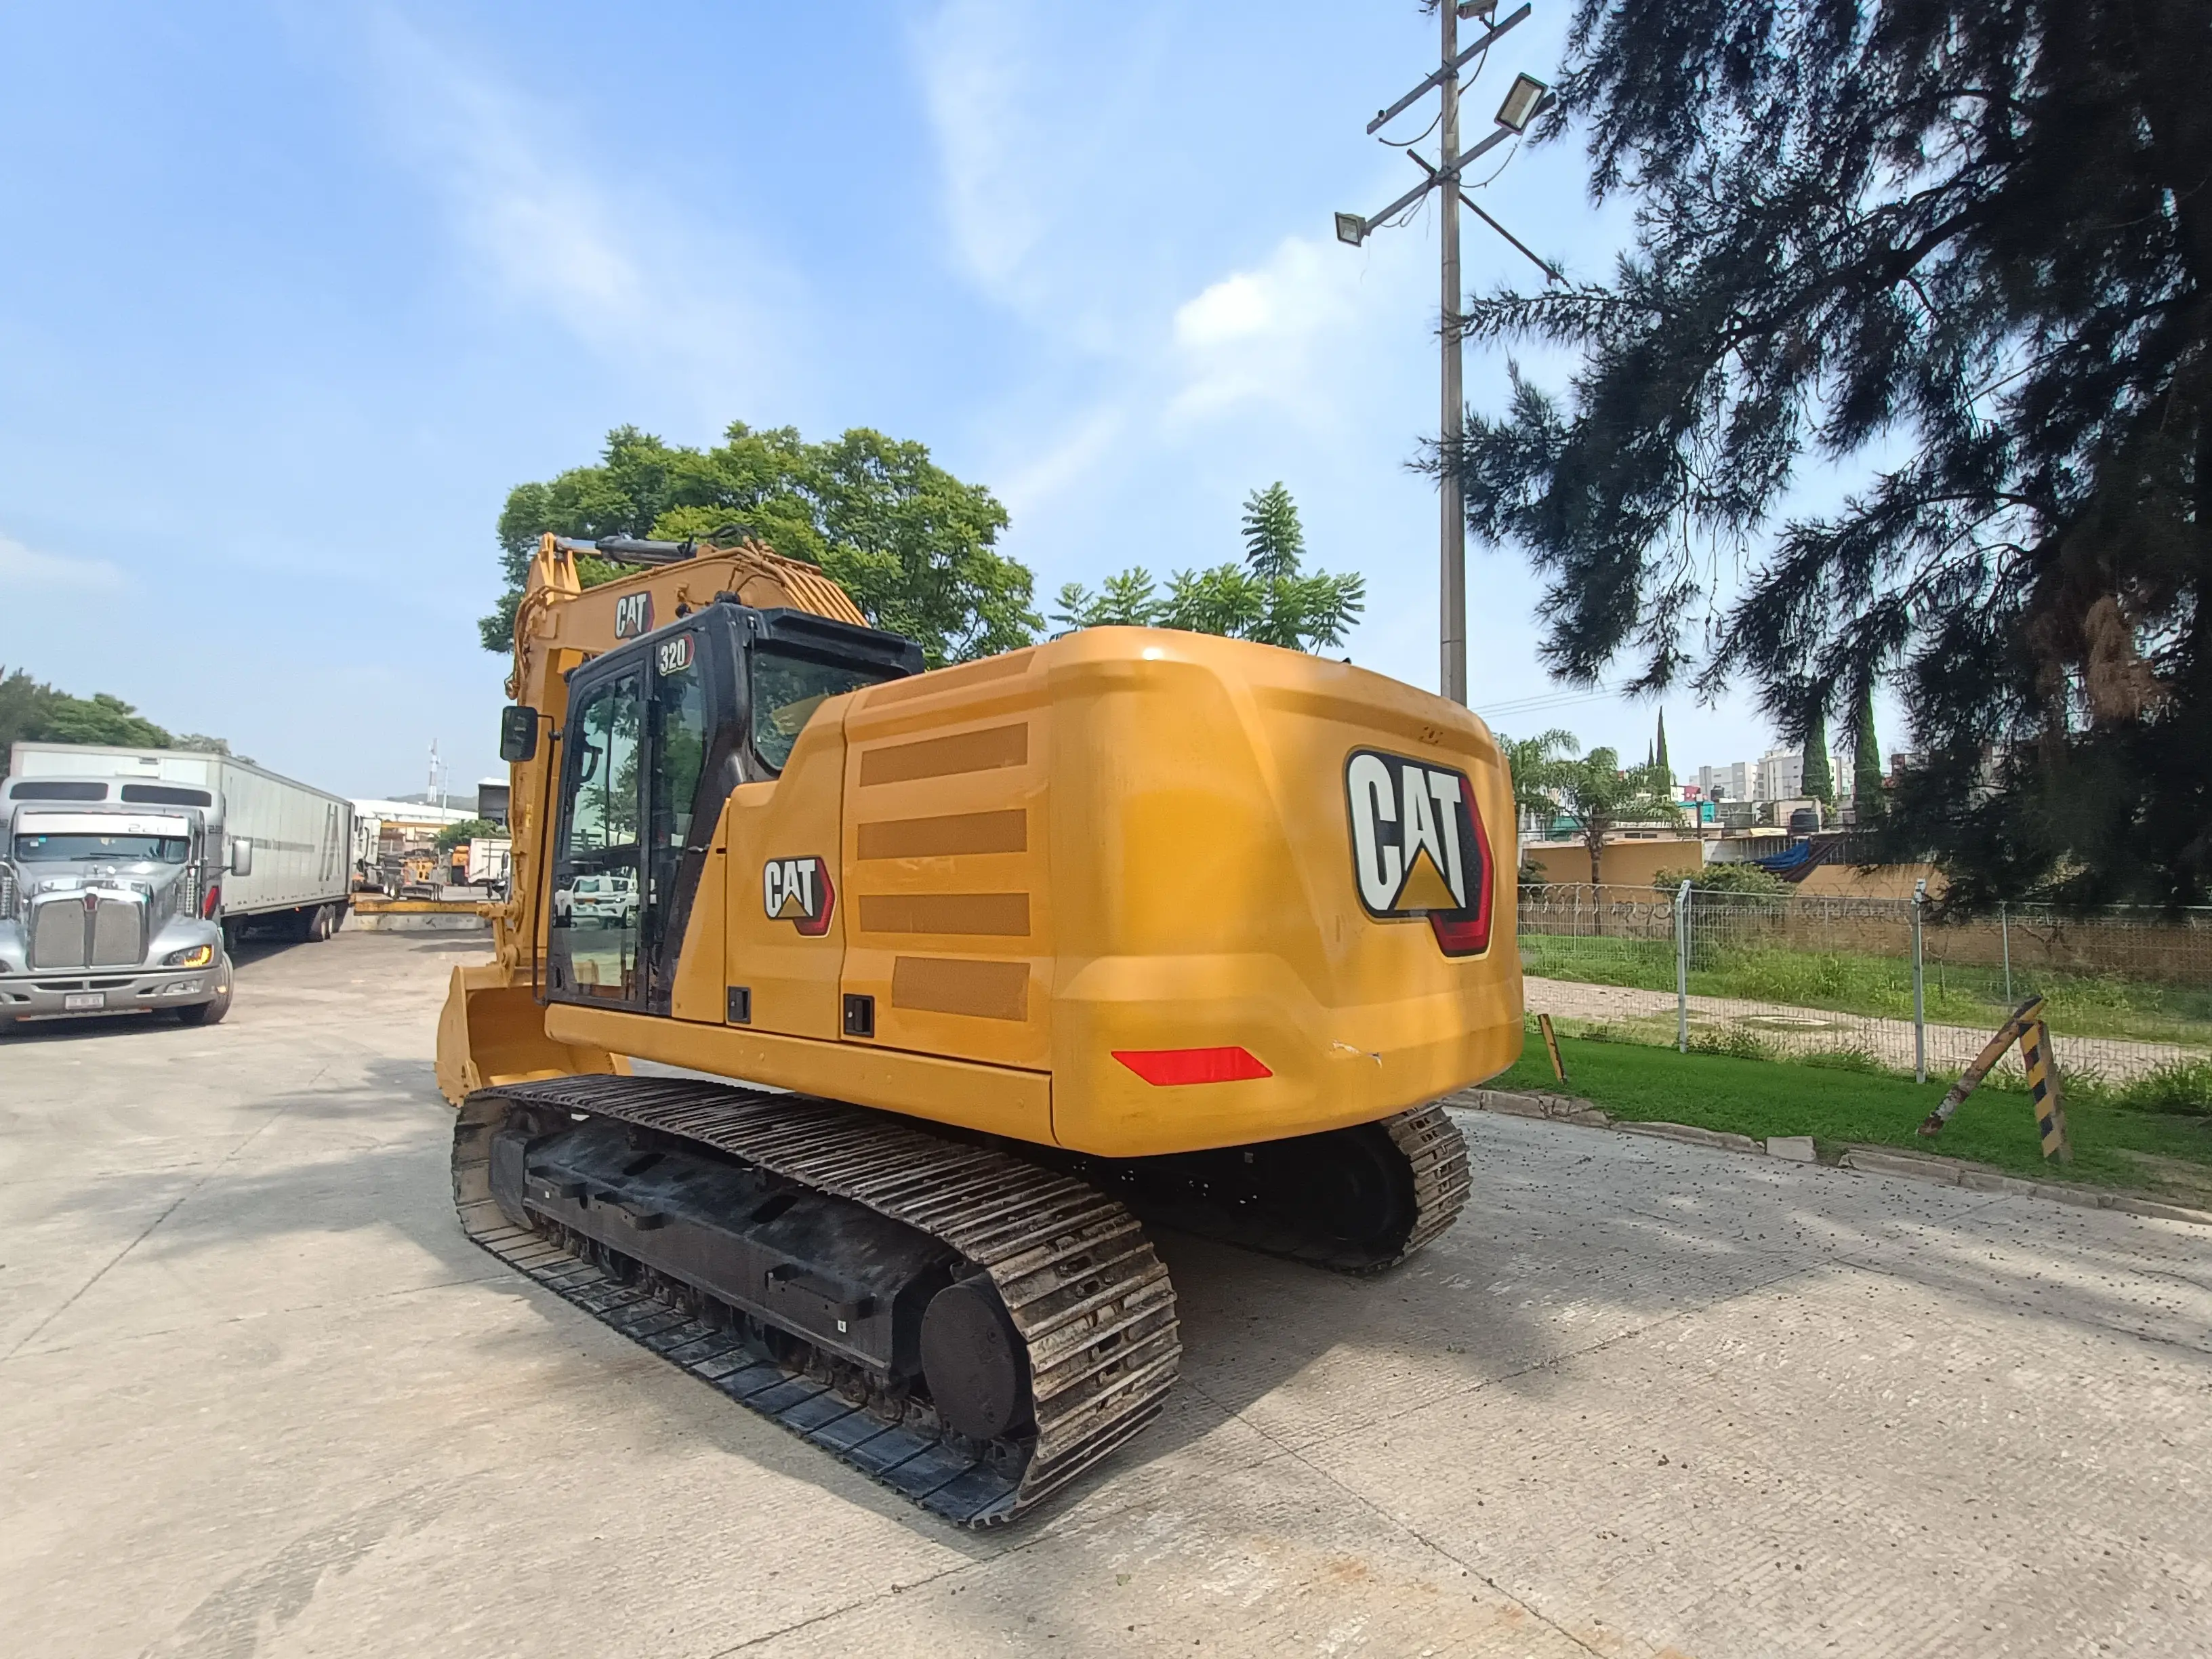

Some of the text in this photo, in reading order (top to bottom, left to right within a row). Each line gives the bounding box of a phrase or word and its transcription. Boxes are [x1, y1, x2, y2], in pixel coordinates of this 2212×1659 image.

[616, 593, 647, 637] CAT
[660, 638, 686, 672] 320
[1349, 754, 1466, 910] CAT
[765, 859, 815, 918] CAT
